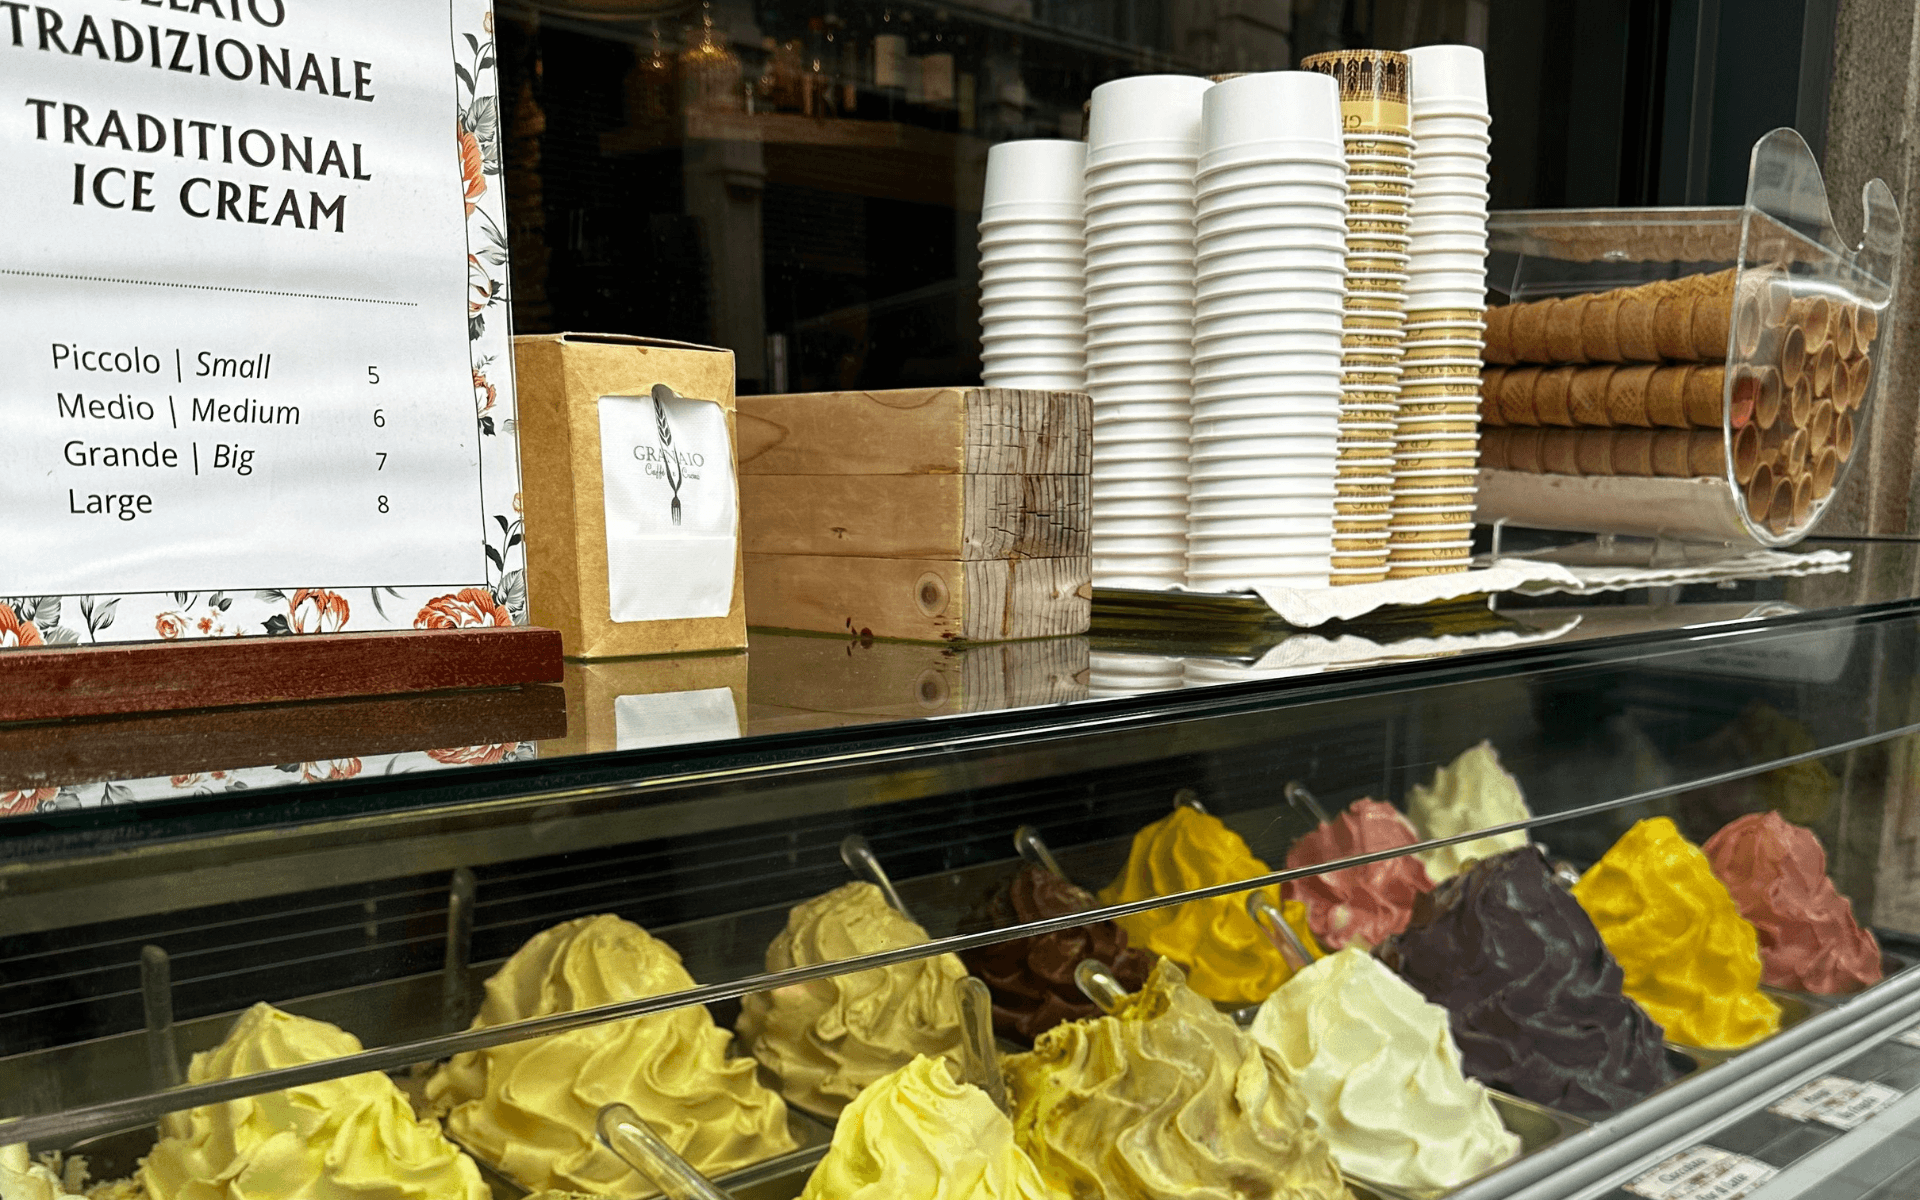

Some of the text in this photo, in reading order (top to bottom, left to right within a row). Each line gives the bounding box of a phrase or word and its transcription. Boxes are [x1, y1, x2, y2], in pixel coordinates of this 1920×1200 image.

[0, 0, 376, 103] TRADIZIONALE
[25, 98, 372, 182] TRADITIONAL
[73, 163, 348, 234] ICE CREAM
[51, 343, 161, 375] Piccolo
[195, 350, 272, 380] Small
[367, 365, 380, 385] 5
[56, 392, 155, 421] Medio
[191, 397, 300, 425] Medium
[373, 408, 386, 429] 6
[63, 440, 178, 468] Grande
[213, 443, 256, 477] Big
[375, 451, 388, 472] 7
[633, 445, 704, 467] GRANAIO
[69, 488, 390, 522] Large 8
